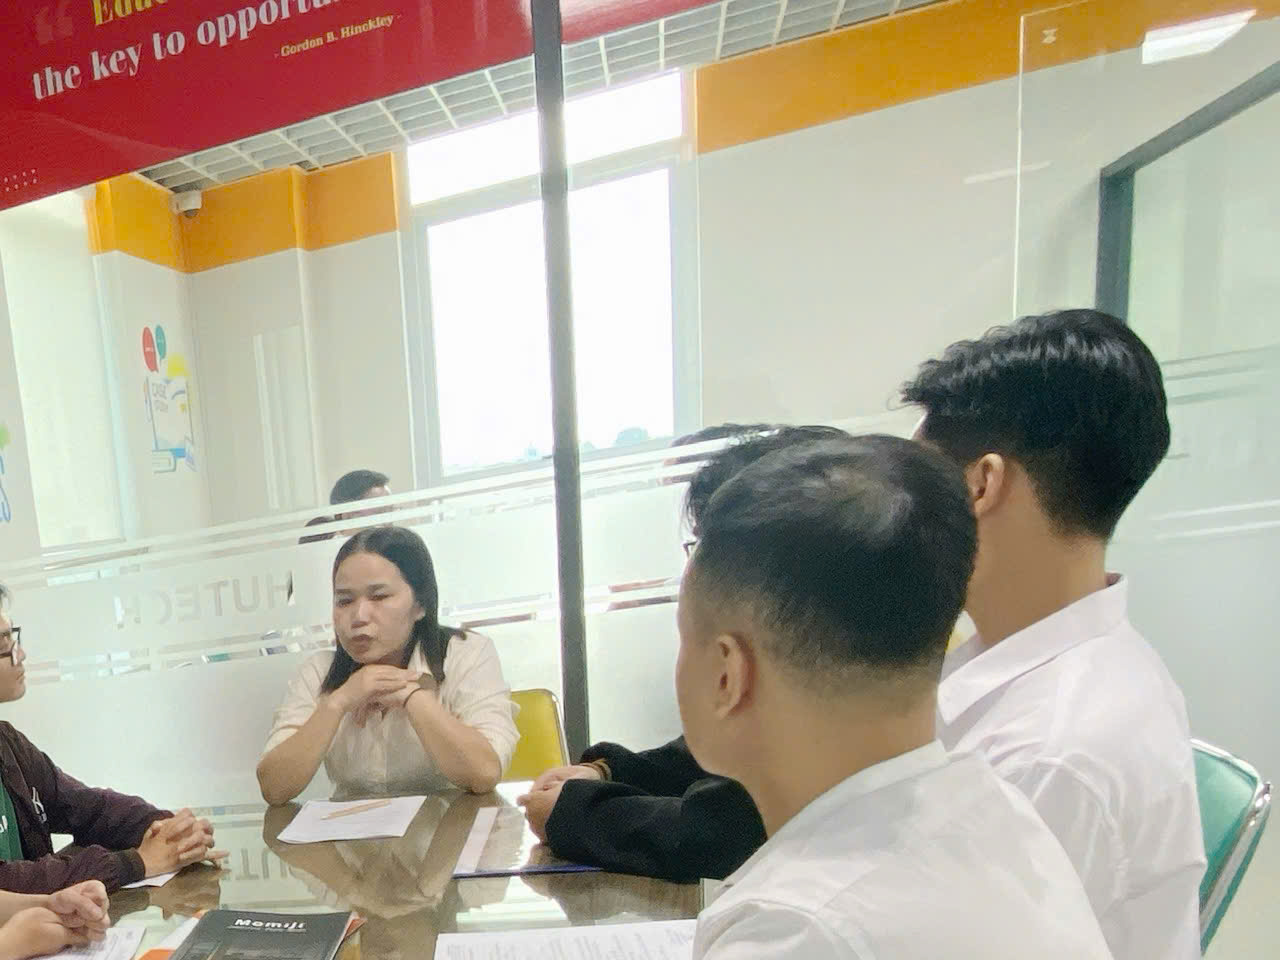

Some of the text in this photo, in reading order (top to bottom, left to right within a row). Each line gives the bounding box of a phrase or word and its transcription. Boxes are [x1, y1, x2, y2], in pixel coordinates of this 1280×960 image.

[33, 0, 340, 100] the key to opport
[281, 15, 394, 57] Gordon B. Hinckley
